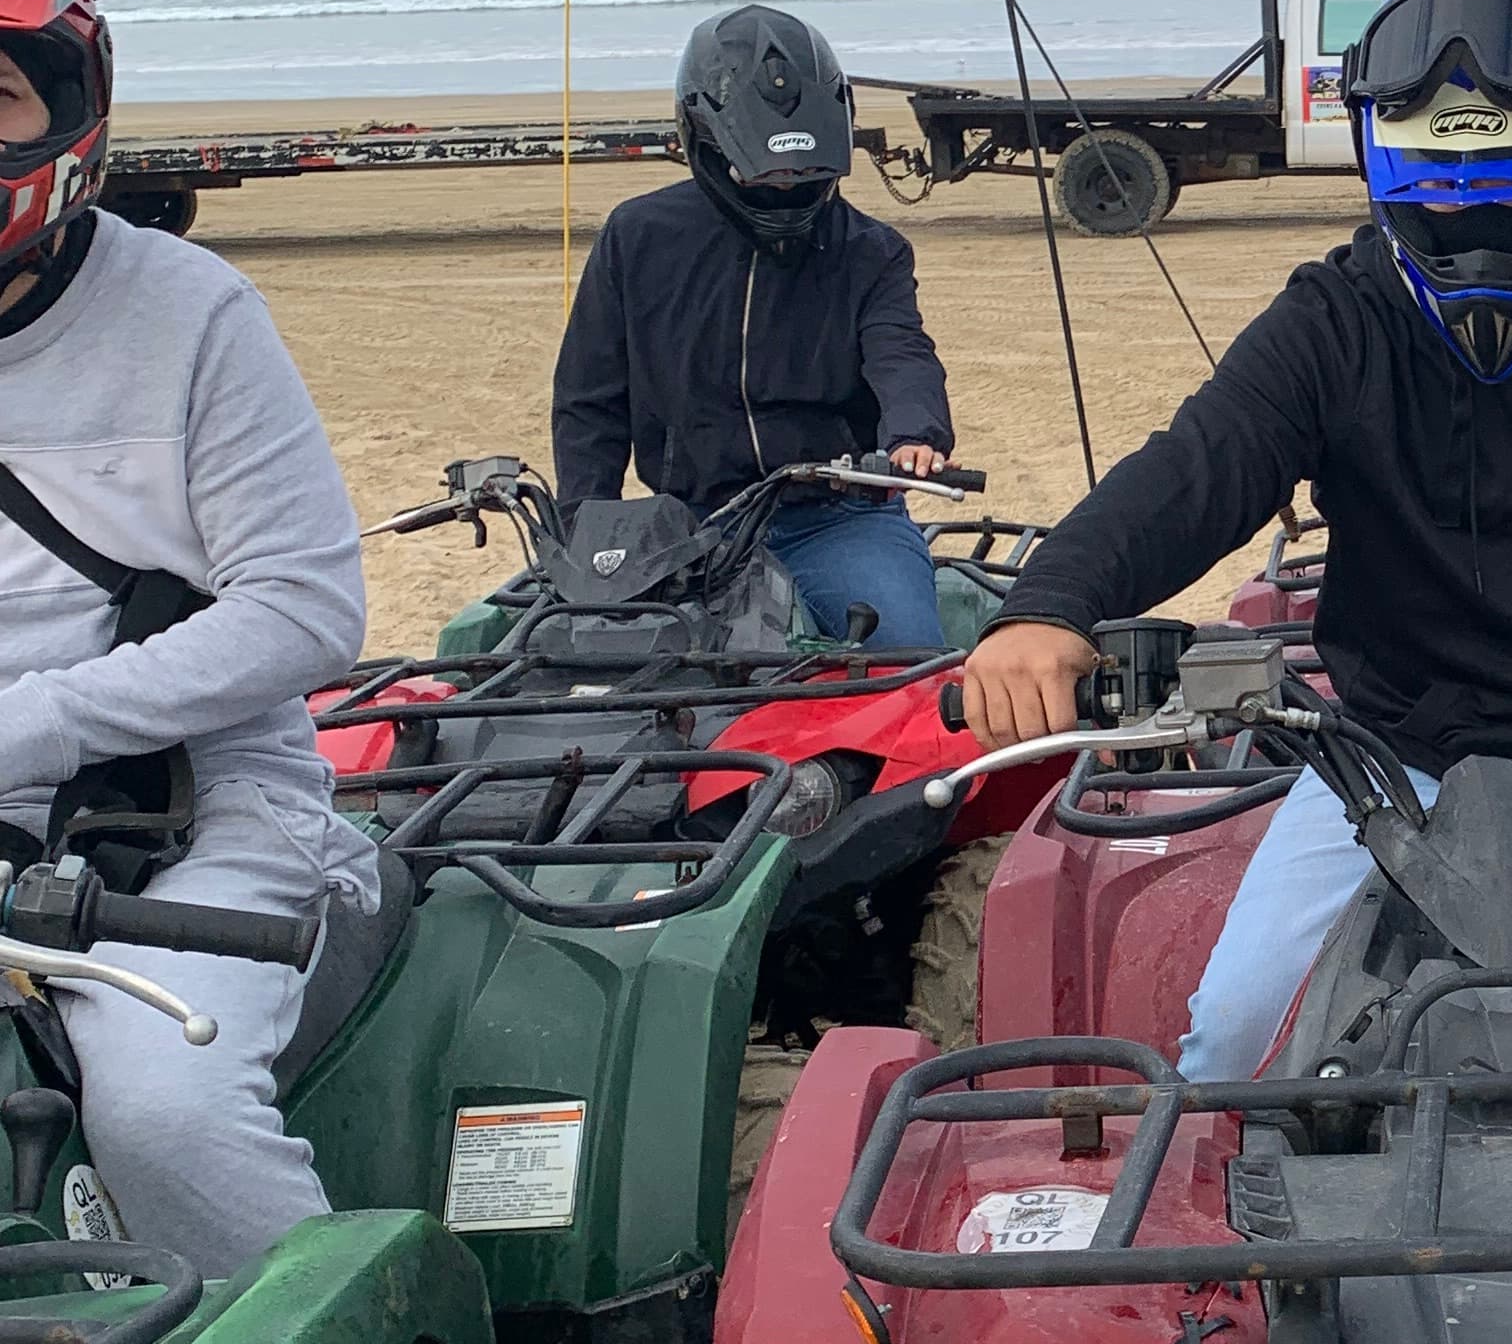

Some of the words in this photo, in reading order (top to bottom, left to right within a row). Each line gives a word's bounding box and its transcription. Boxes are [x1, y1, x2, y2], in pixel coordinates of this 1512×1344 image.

[72, 1178, 97, 1209] QL
[1015, 1192, 1069, 1206] QL
[995, 1230, 1064, 1246] 107
